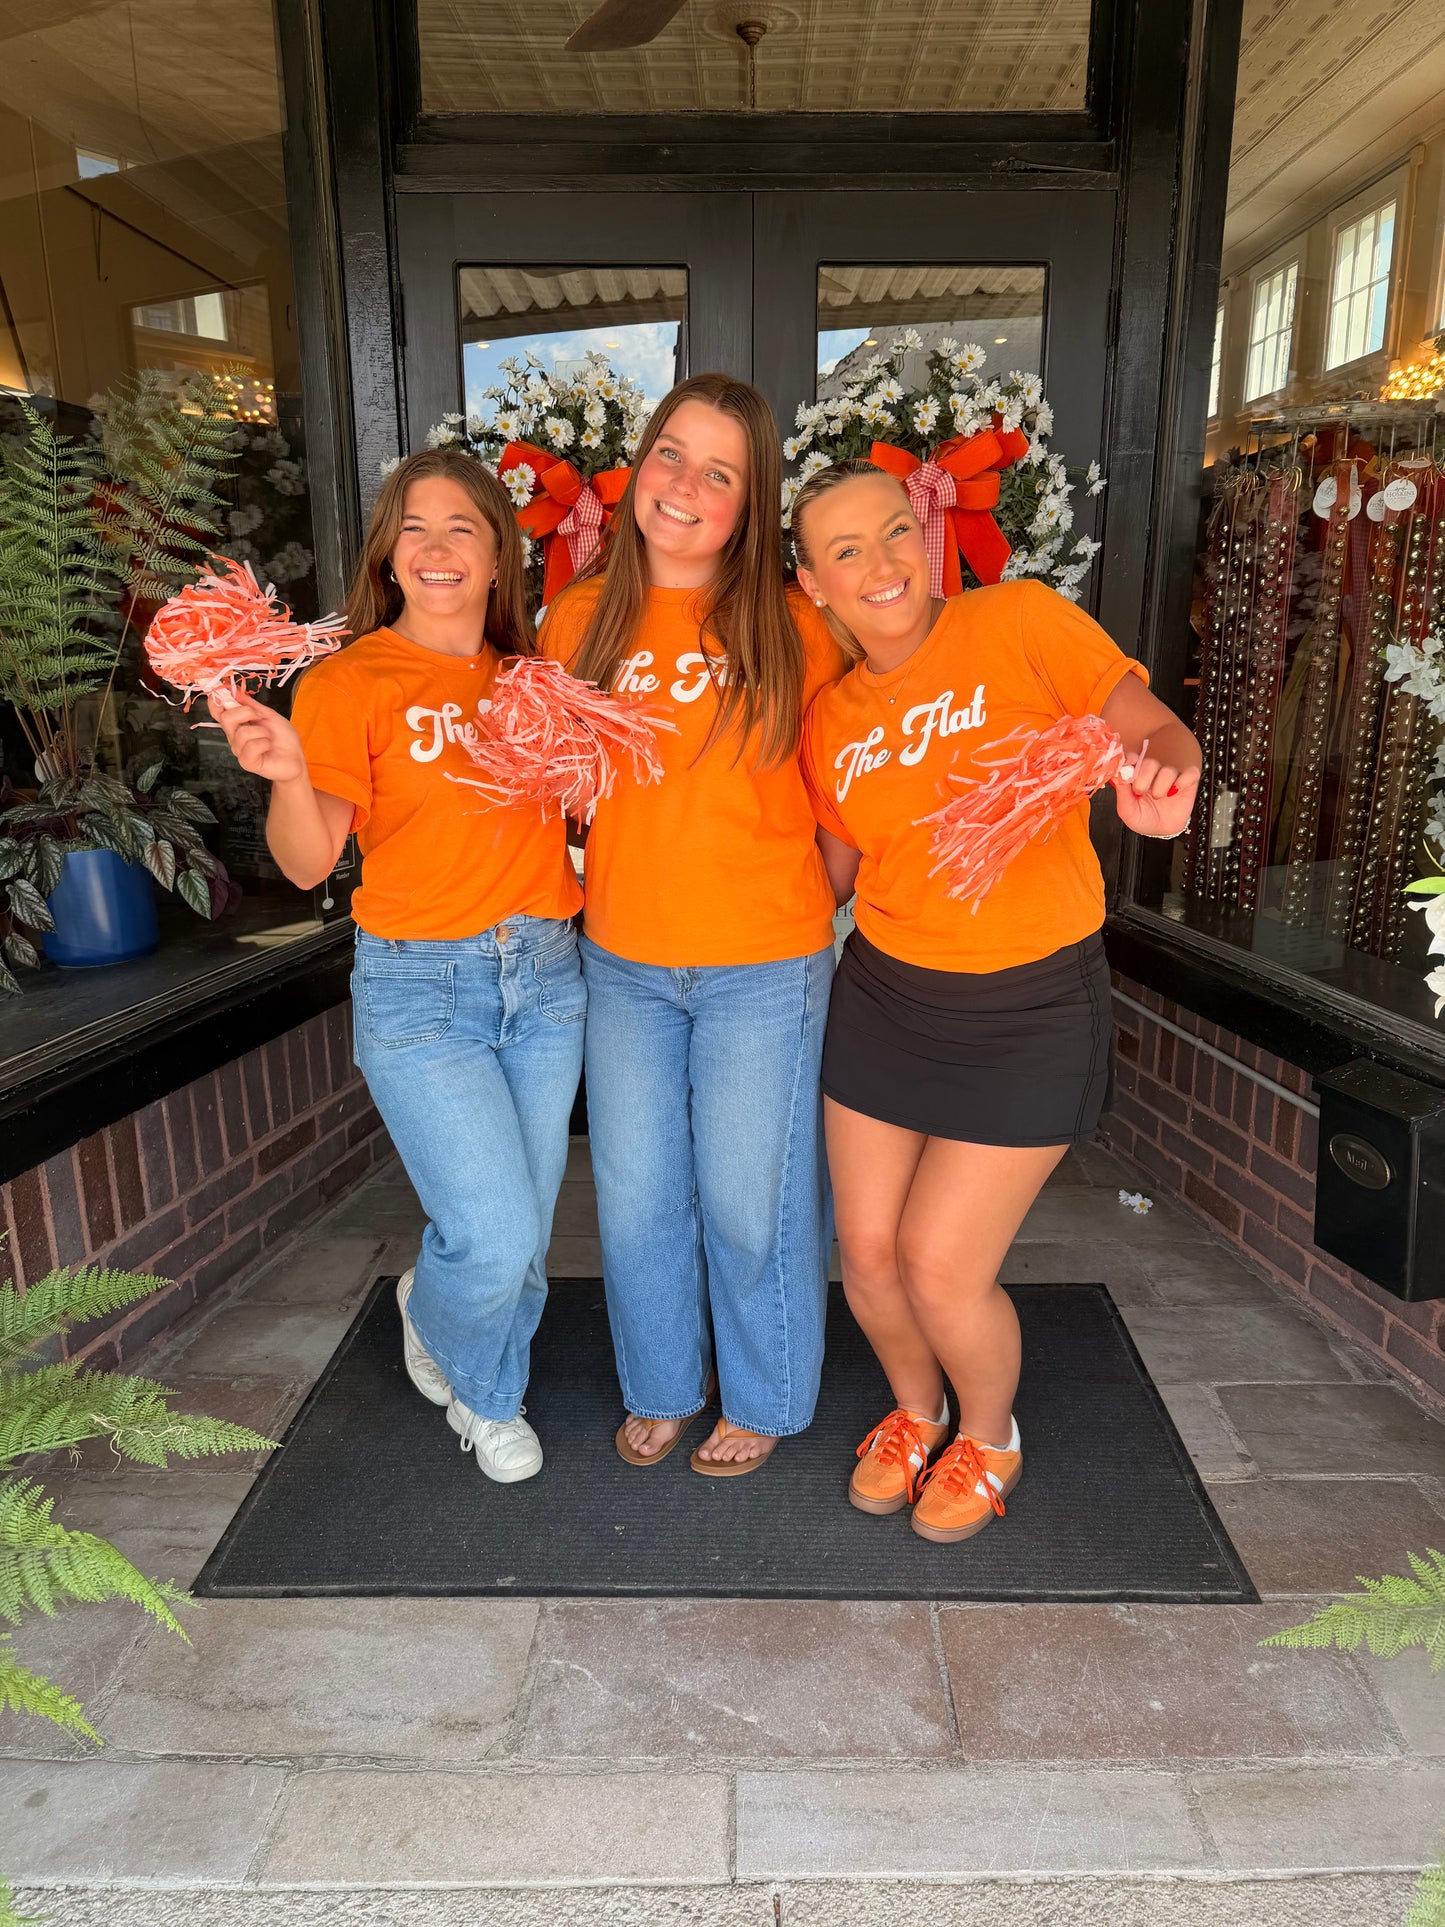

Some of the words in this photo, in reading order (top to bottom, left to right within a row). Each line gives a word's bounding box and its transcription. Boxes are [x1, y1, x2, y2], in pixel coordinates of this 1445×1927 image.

[1386, 490, 1415, 498] HOSKINS
[670, 652, 762, 703] Fl
[405, 702, 479, 763] The
[834, 726, 892, 804] The
[899, 684, 987, 767] Flat
[1346, 1151, 1368, 1171] Mail
